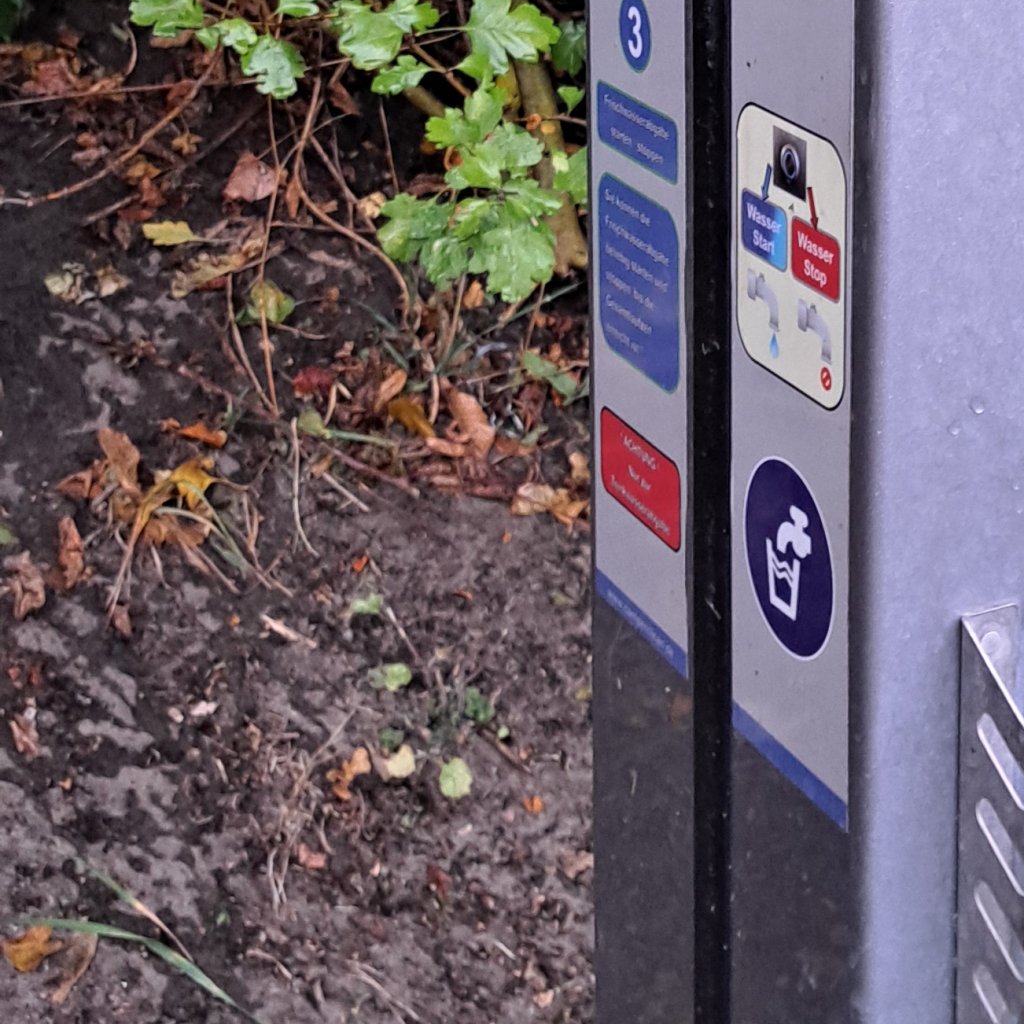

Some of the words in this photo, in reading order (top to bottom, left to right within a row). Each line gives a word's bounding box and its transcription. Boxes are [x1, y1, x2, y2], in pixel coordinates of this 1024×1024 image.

[627, 5, 644, 59] 3
[746, 202, 783, 234] Wasser
[752, 228, 776, 256] Start
[797, 230, 835, 265] Wasser
[803, 258, 828, 289] Stop
